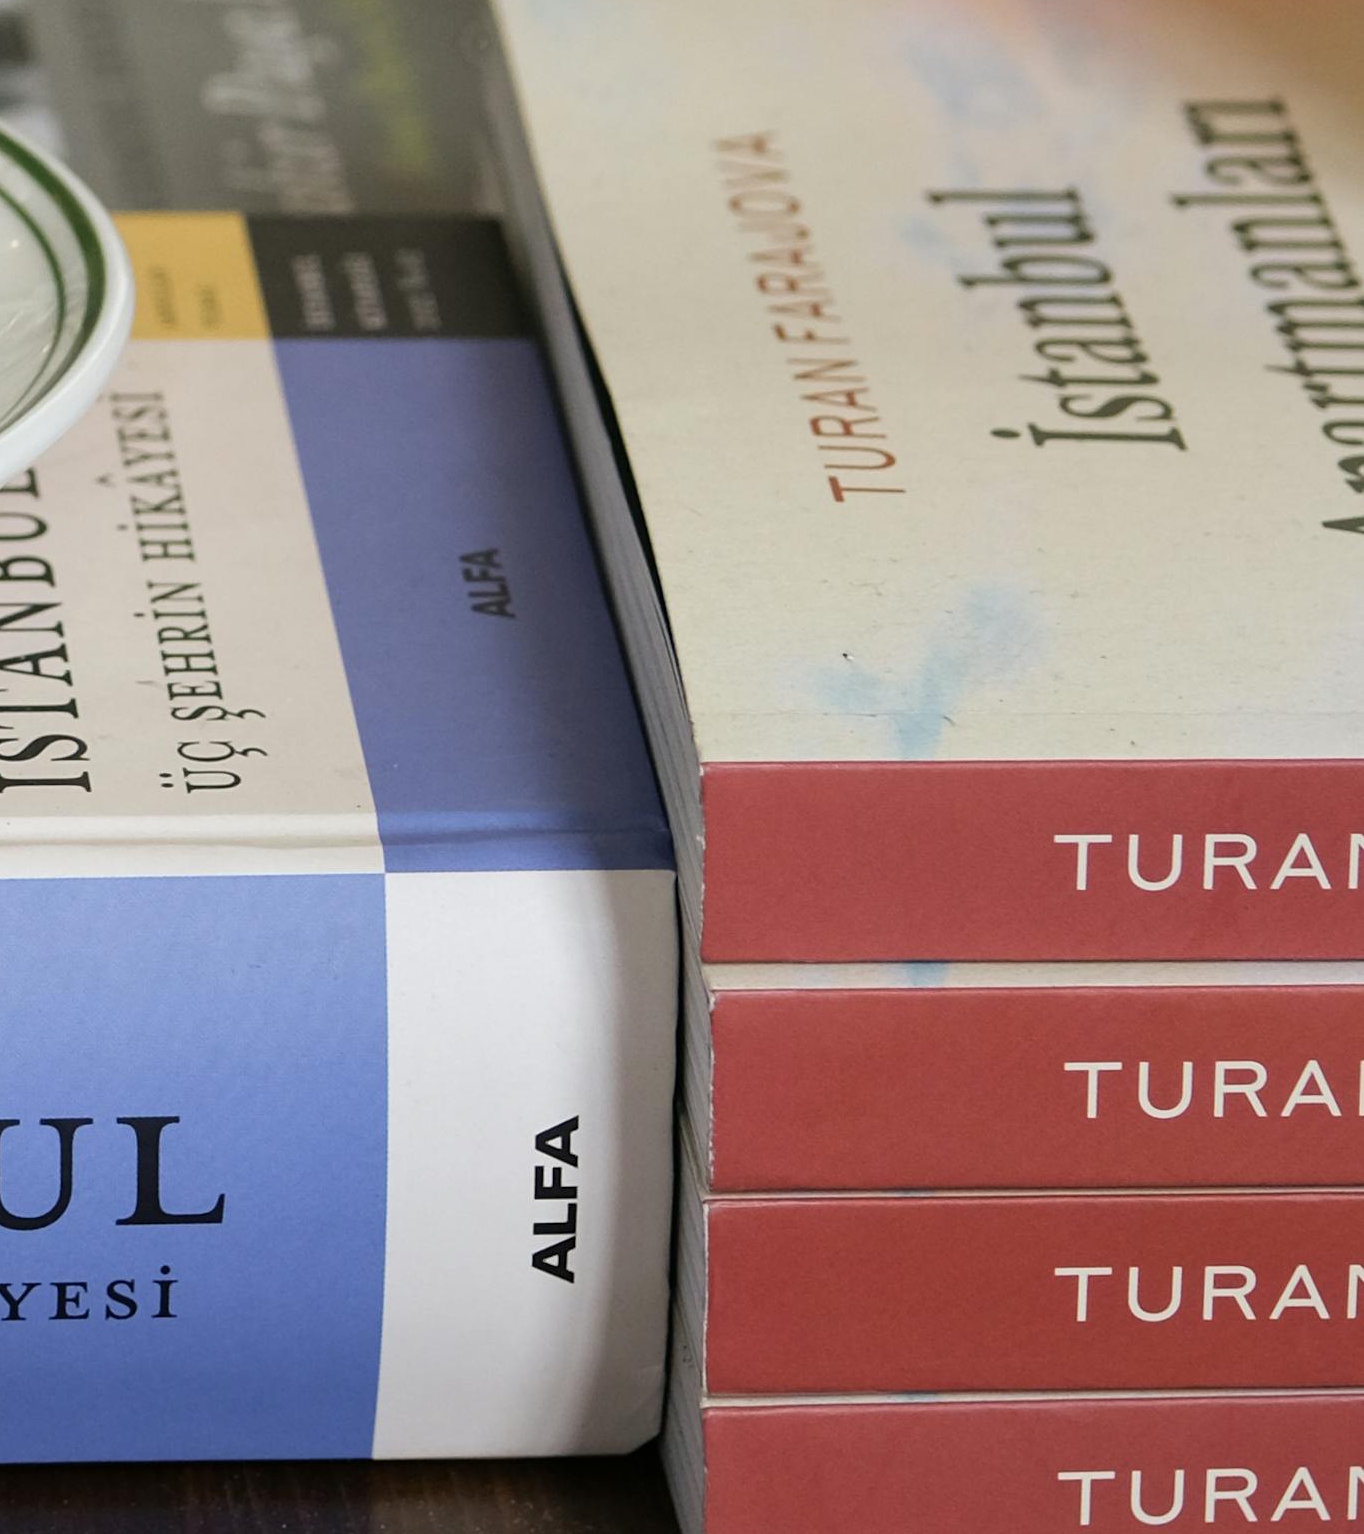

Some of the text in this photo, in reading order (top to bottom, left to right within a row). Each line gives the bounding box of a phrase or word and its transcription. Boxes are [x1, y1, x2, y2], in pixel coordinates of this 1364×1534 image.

[713, 130, 906, 503] TURAN FARAJOVA
[925, 187, 1187, 452] İstanbul
[133, 581, 265, 725] ŞEHRİN
[459, 548, 516, 619] ALFA
[160, 735, 267, 794] ÜÇ
[1064, 1060, 1364, 1119] TURA
[531, 1115, 580, 1284] ALFA
